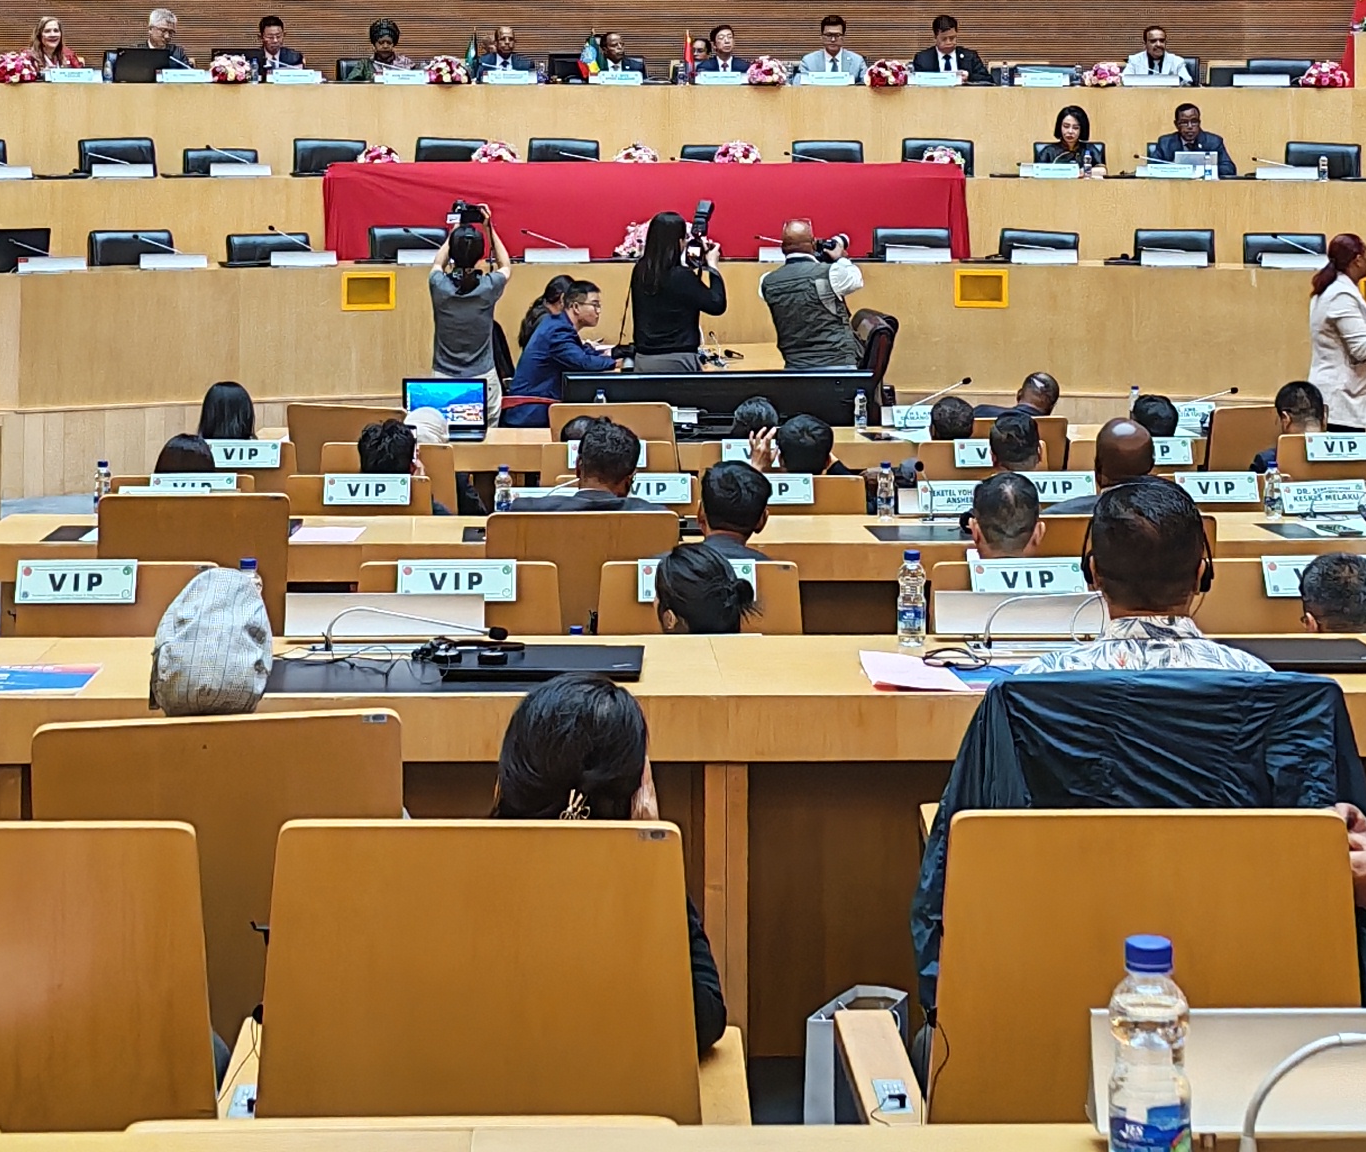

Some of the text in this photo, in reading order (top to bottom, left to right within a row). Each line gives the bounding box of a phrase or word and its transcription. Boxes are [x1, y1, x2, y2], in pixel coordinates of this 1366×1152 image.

[1325, 440, 1358, 453] VIP
[223, 447, 259, 461] VIP
[347, 482, 387, 498] VIP
[631, 482, 667, 496] VIP
[1038, 481, 1073, 494] VIP
[1198, 481, 1236, 495] VIP
[49, 573, 102, 592] VIP
[429, 571, 483, 591] VIP
[1004, 570, 1054, 589] VIP
